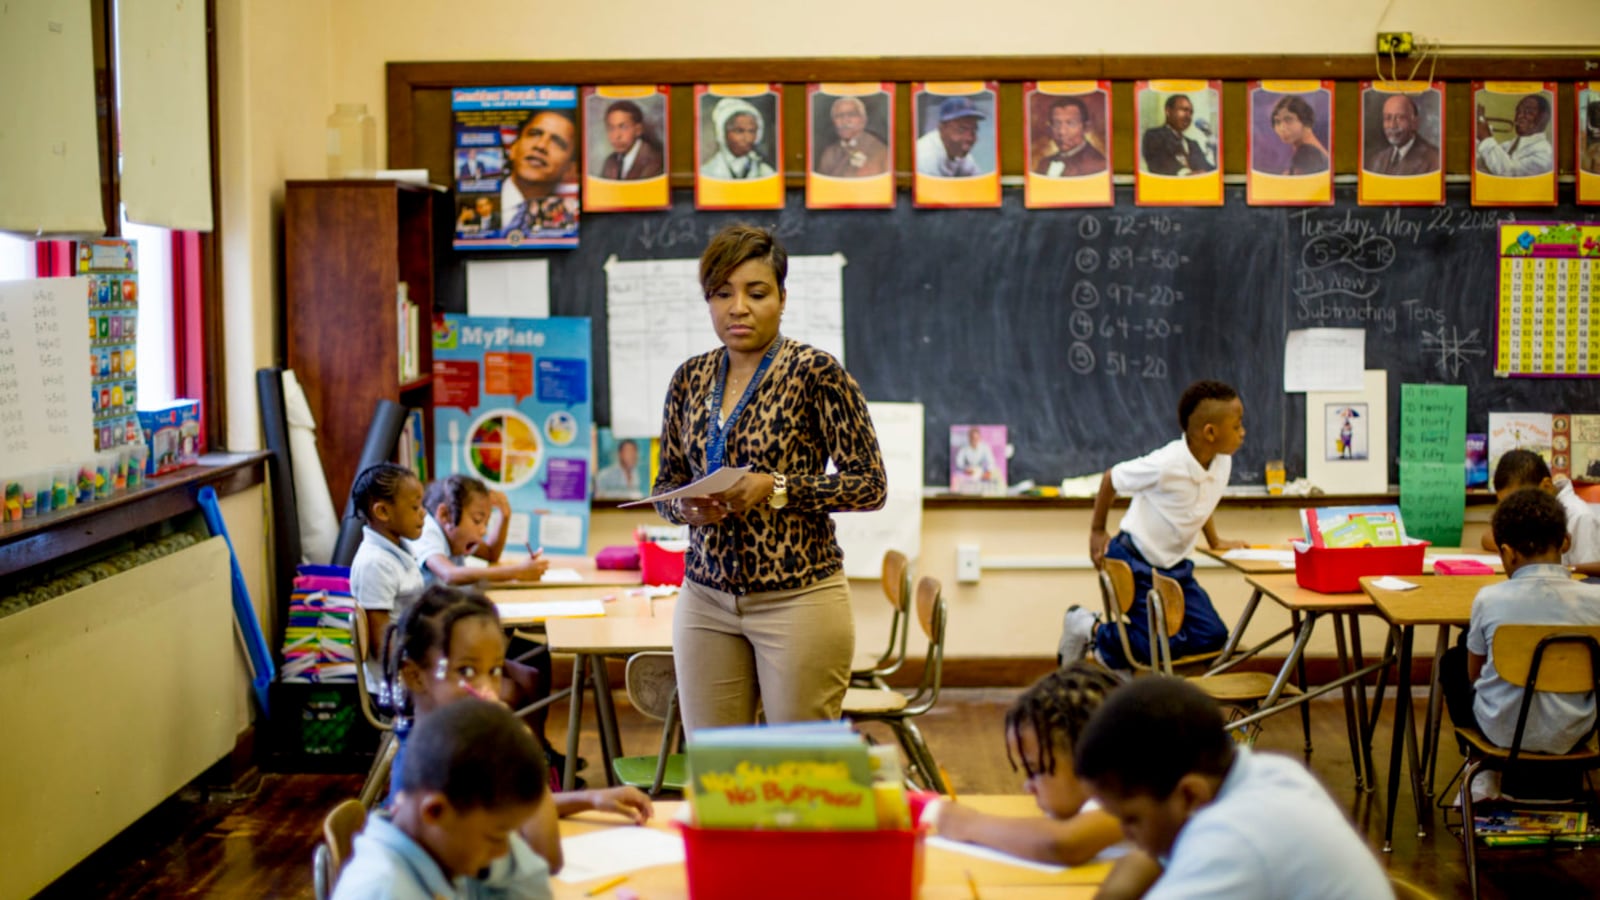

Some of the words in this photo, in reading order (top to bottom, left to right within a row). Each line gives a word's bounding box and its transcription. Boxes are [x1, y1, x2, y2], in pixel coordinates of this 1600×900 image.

[1381, 209, 1421, 243] May
[1459, 210, 1497, 231] 2018
[1297, 299, 1396, 332] Subtracting
[1402, 298, 1446, 323] Tens
[461, 327, 545, 349] MyPlate
